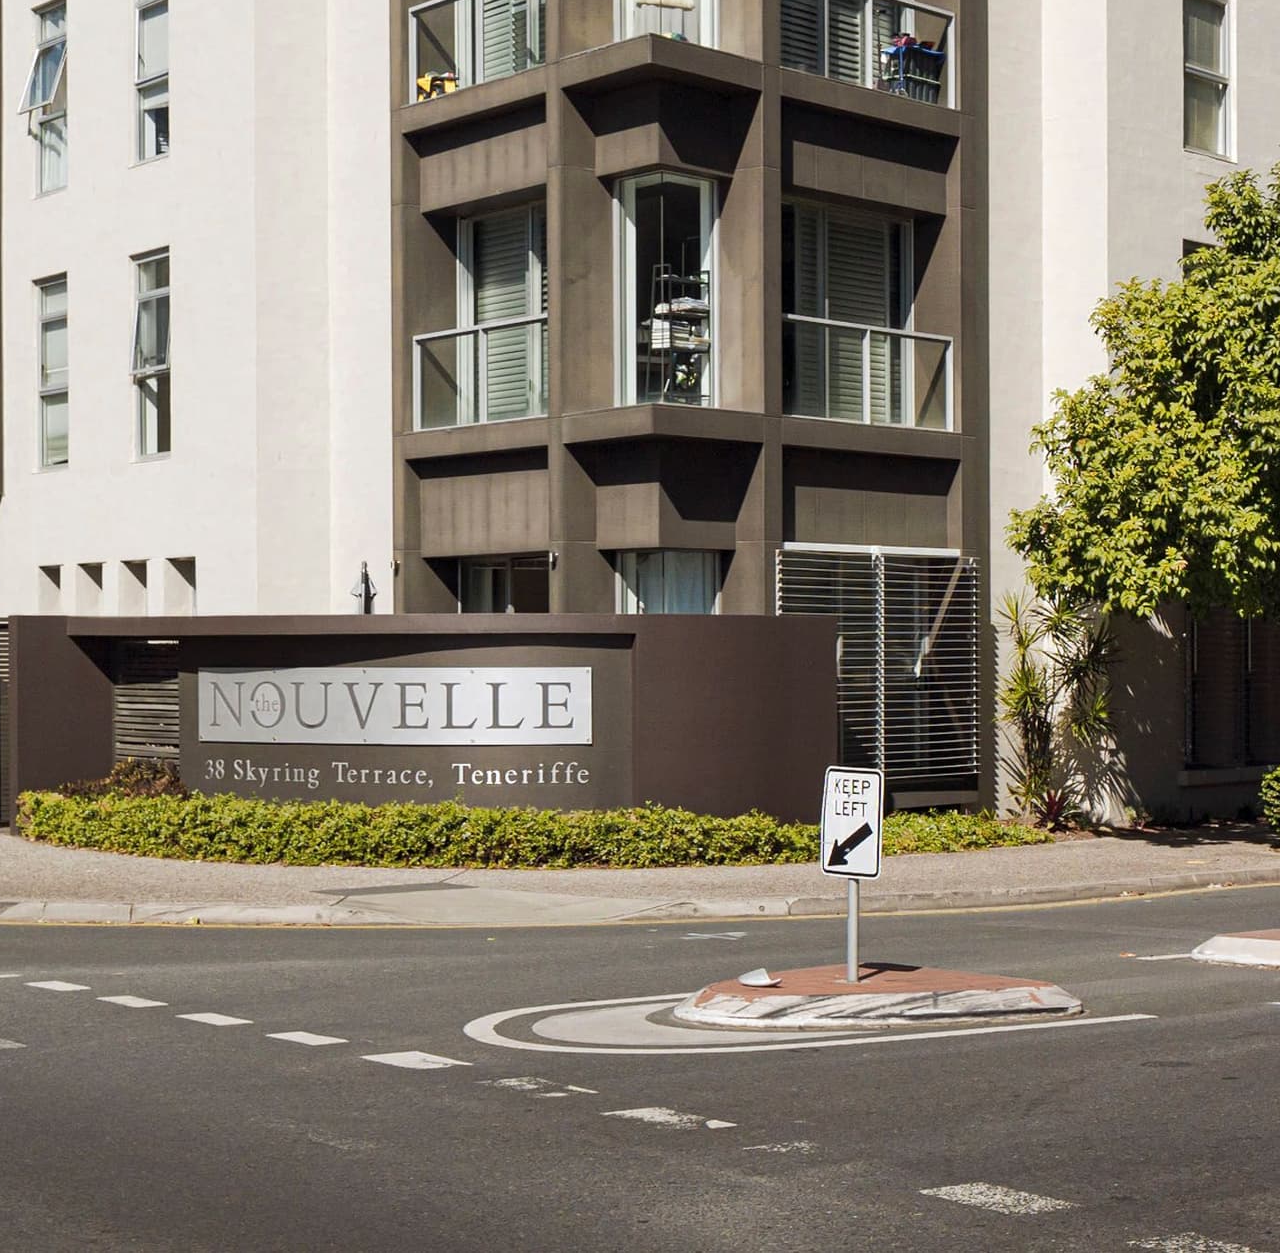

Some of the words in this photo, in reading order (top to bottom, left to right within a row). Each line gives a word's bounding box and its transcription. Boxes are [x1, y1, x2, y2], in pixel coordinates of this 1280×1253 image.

[209, 681, 575, 730] NOUVELLE
[255, 692, 280, 713] the
[204, 758, 226, 781] 38
[233, 758, 321, 789] Skyring
[332, 761, 434, 788] Terrace,
[452, 762, 590, 785] Teneriffe
[834, 778, 871, 795] KEEP
[835, 800, 867, 817] LEFT
